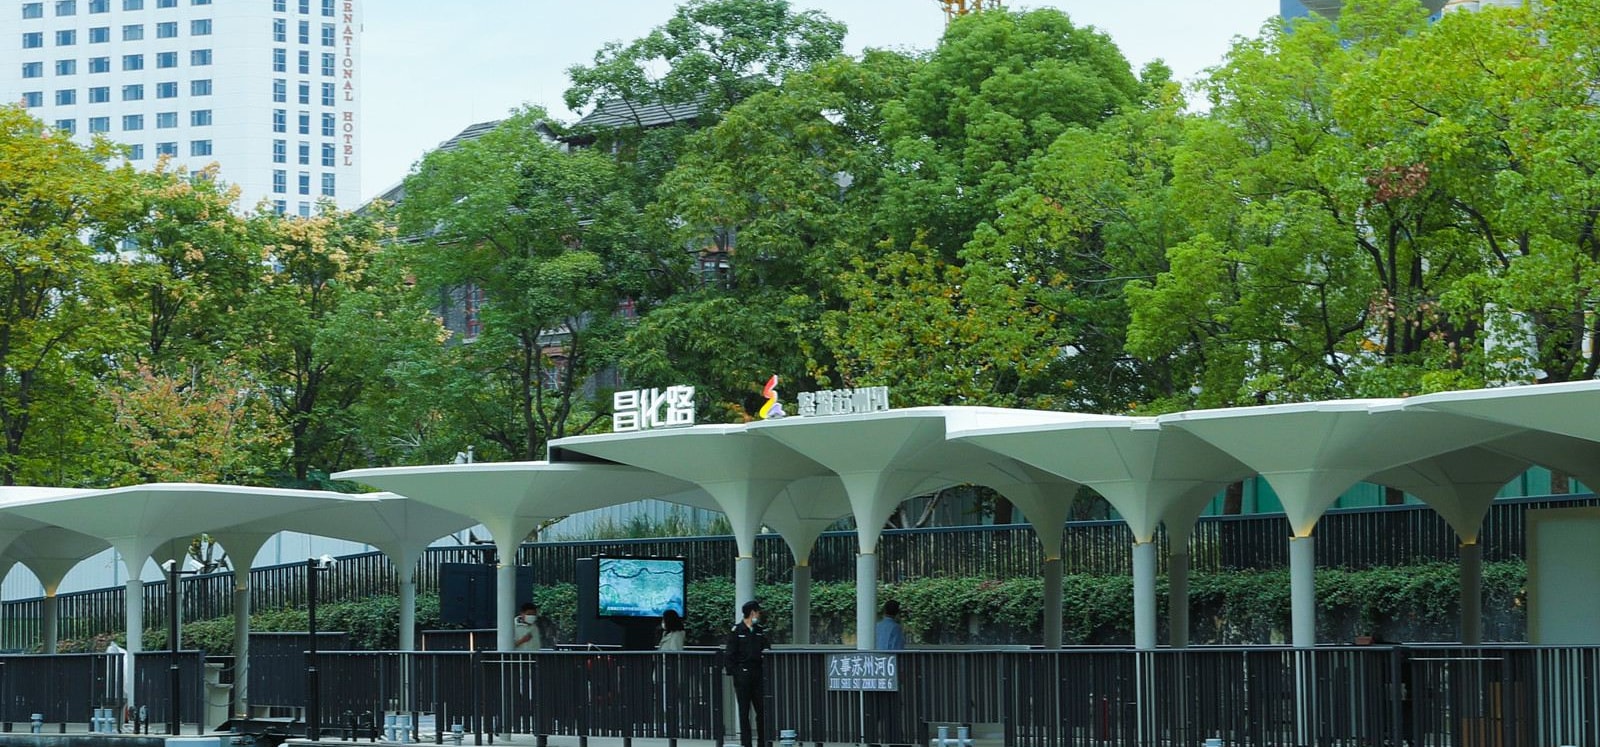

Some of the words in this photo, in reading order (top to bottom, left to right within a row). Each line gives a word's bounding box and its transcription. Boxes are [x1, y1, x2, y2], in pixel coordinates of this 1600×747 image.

[343, 0, 353, 101] RNATIONAL
[343, 112, 353, 166] HOTEL
[613, 385, 695, 432] 昌化路
[887, 678, 892, 689] 6
